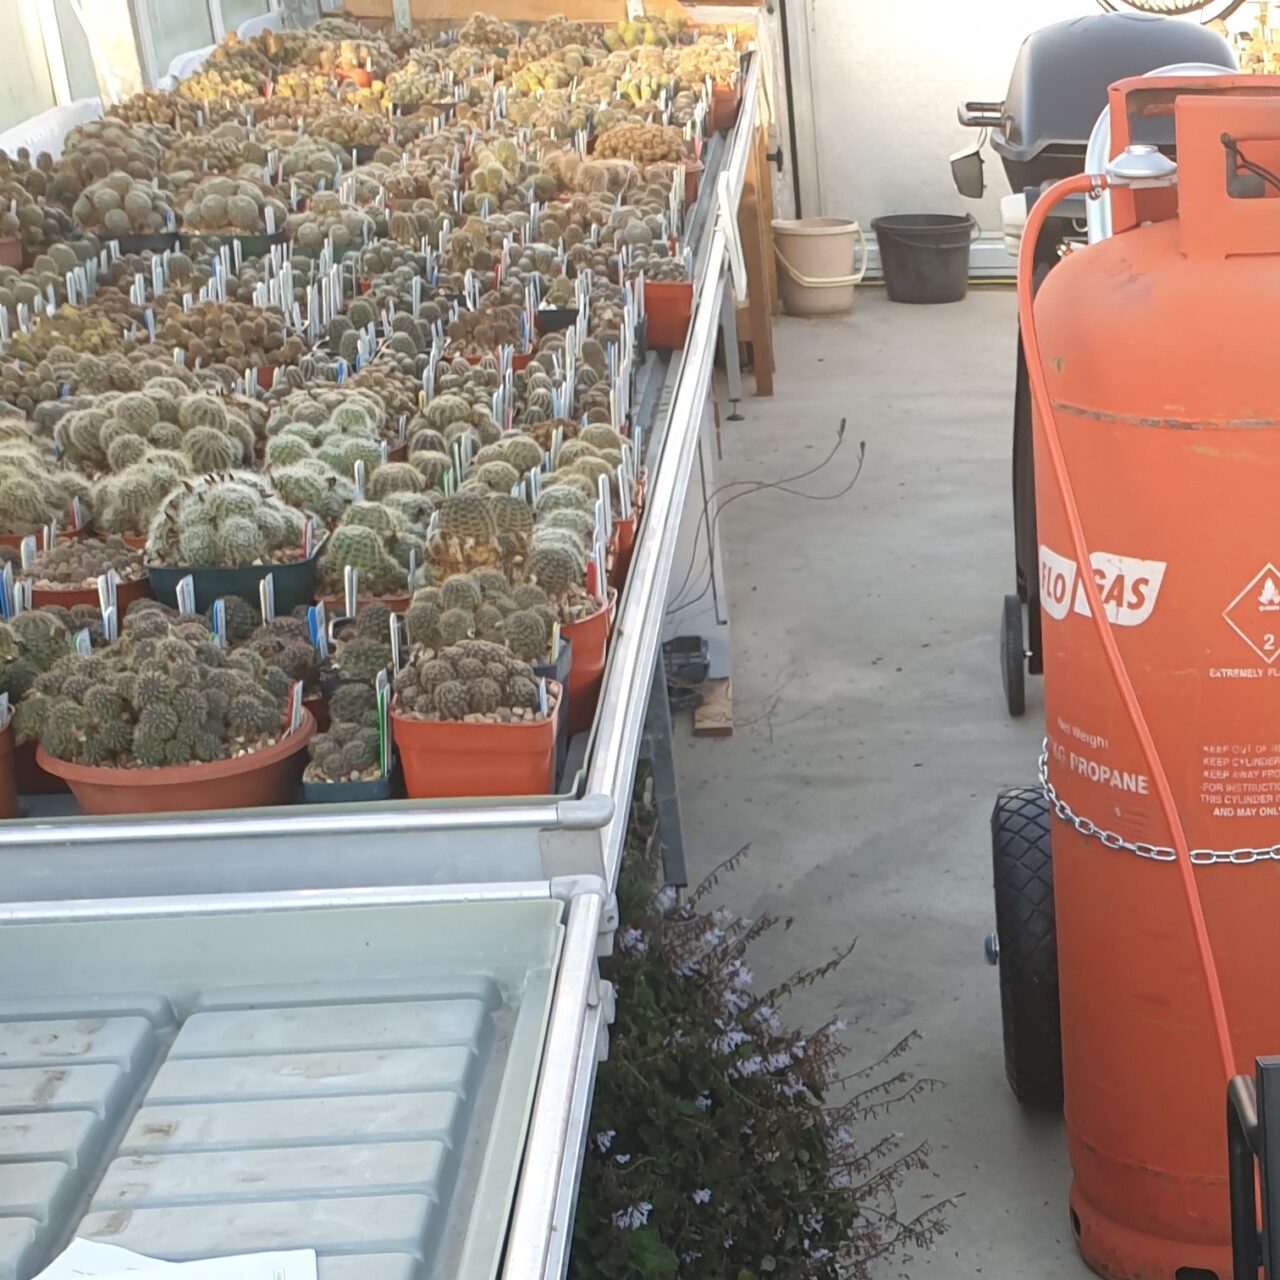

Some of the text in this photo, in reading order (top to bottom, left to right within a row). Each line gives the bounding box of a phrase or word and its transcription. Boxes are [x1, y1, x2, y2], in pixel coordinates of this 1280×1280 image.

[1263, 633, 1275, 650] 2
[1209, 667, 1264, 679] EXTREMELY
[1070, 751, 1150, 796] PROPANE
[1224, 794, 1273, 805] CYLINDER
[1213, 806, 1235, 817] AND
[1236, 806, 1257, 817] MAY
